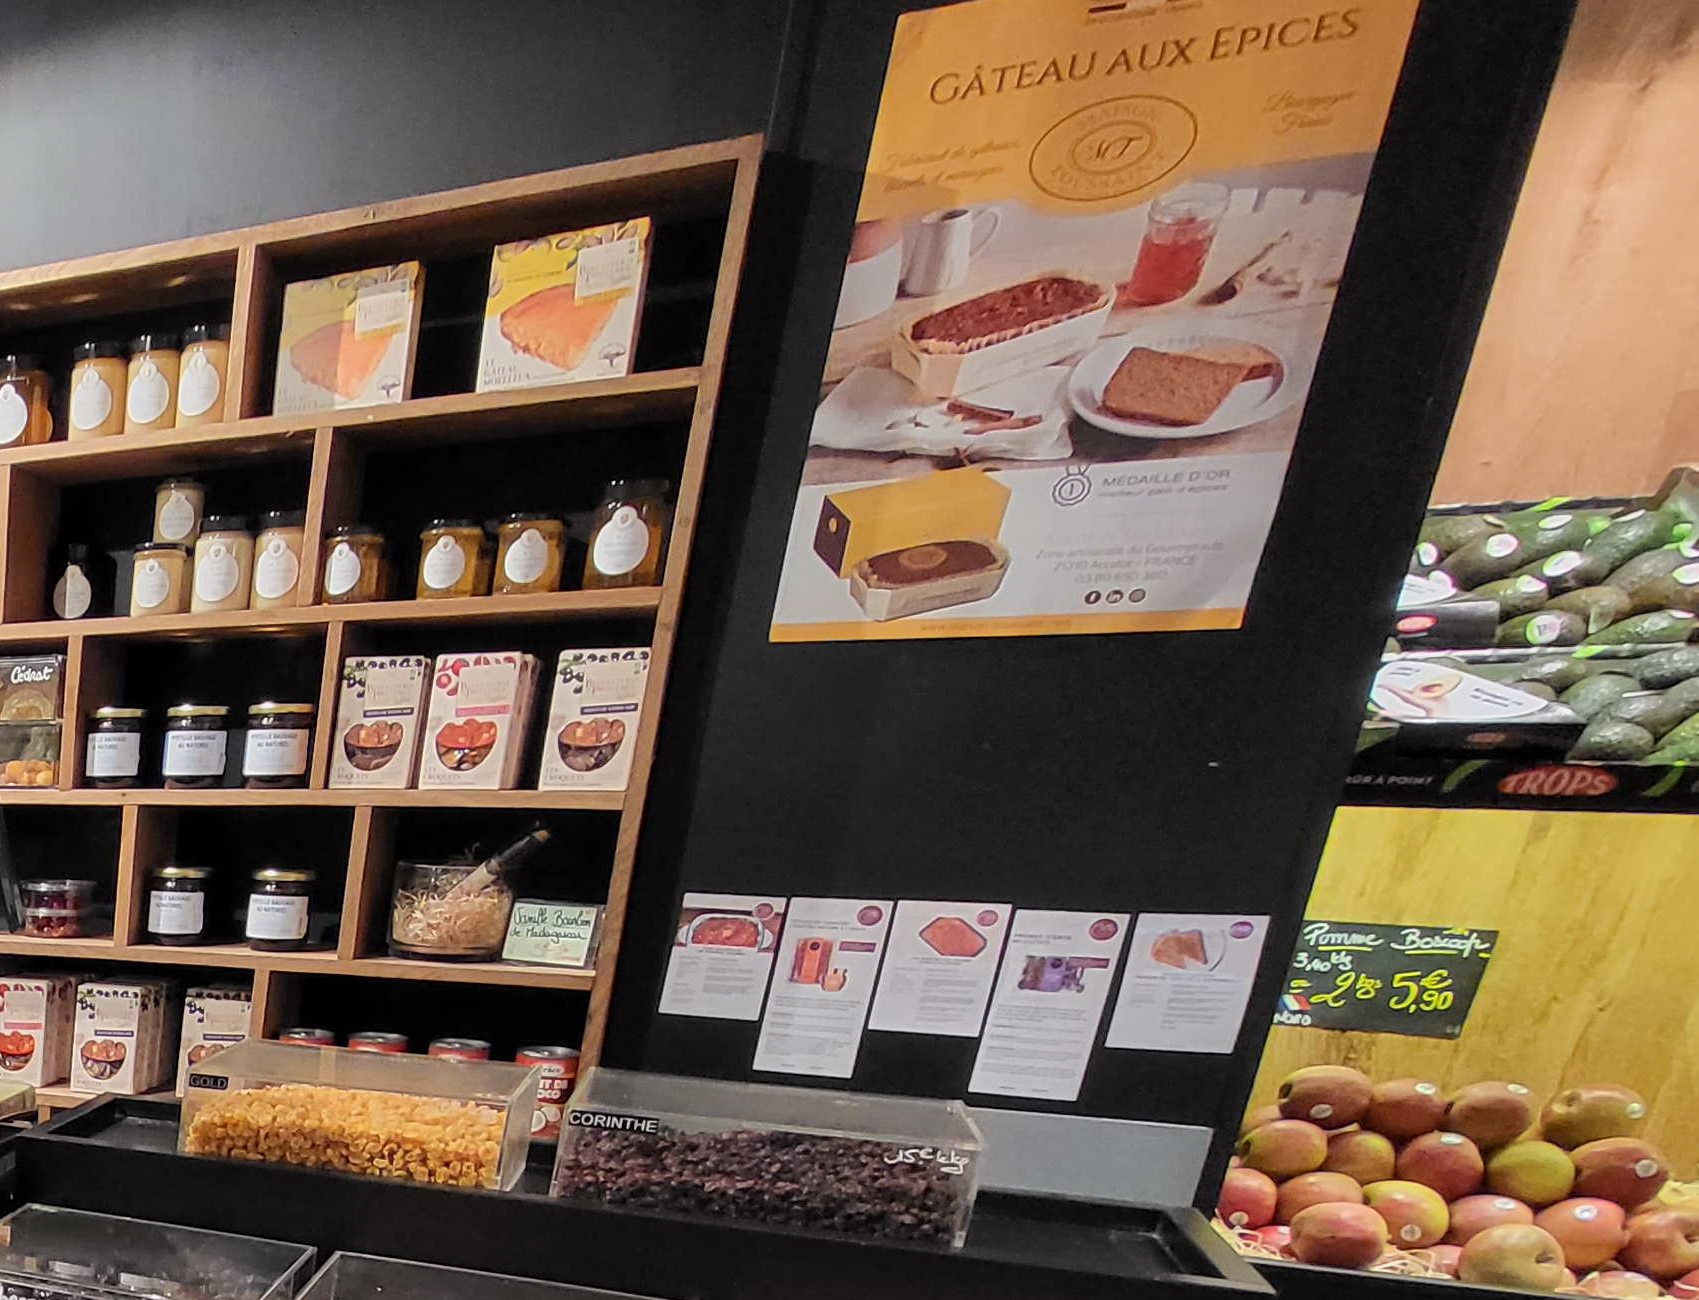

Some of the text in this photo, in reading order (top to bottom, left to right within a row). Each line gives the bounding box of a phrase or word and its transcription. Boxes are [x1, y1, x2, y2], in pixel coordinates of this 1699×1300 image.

[1105, 37, 1198, 78] AUX
[11, 665, 54, 684] Cédrat
[1501, 768, 1607, 796] TROPS
[1303, 922, 1385, 947] Pomme
[190, 1075, 228, 1089] GOLD
[569, 1112, 659, 1134] CORINTHE
